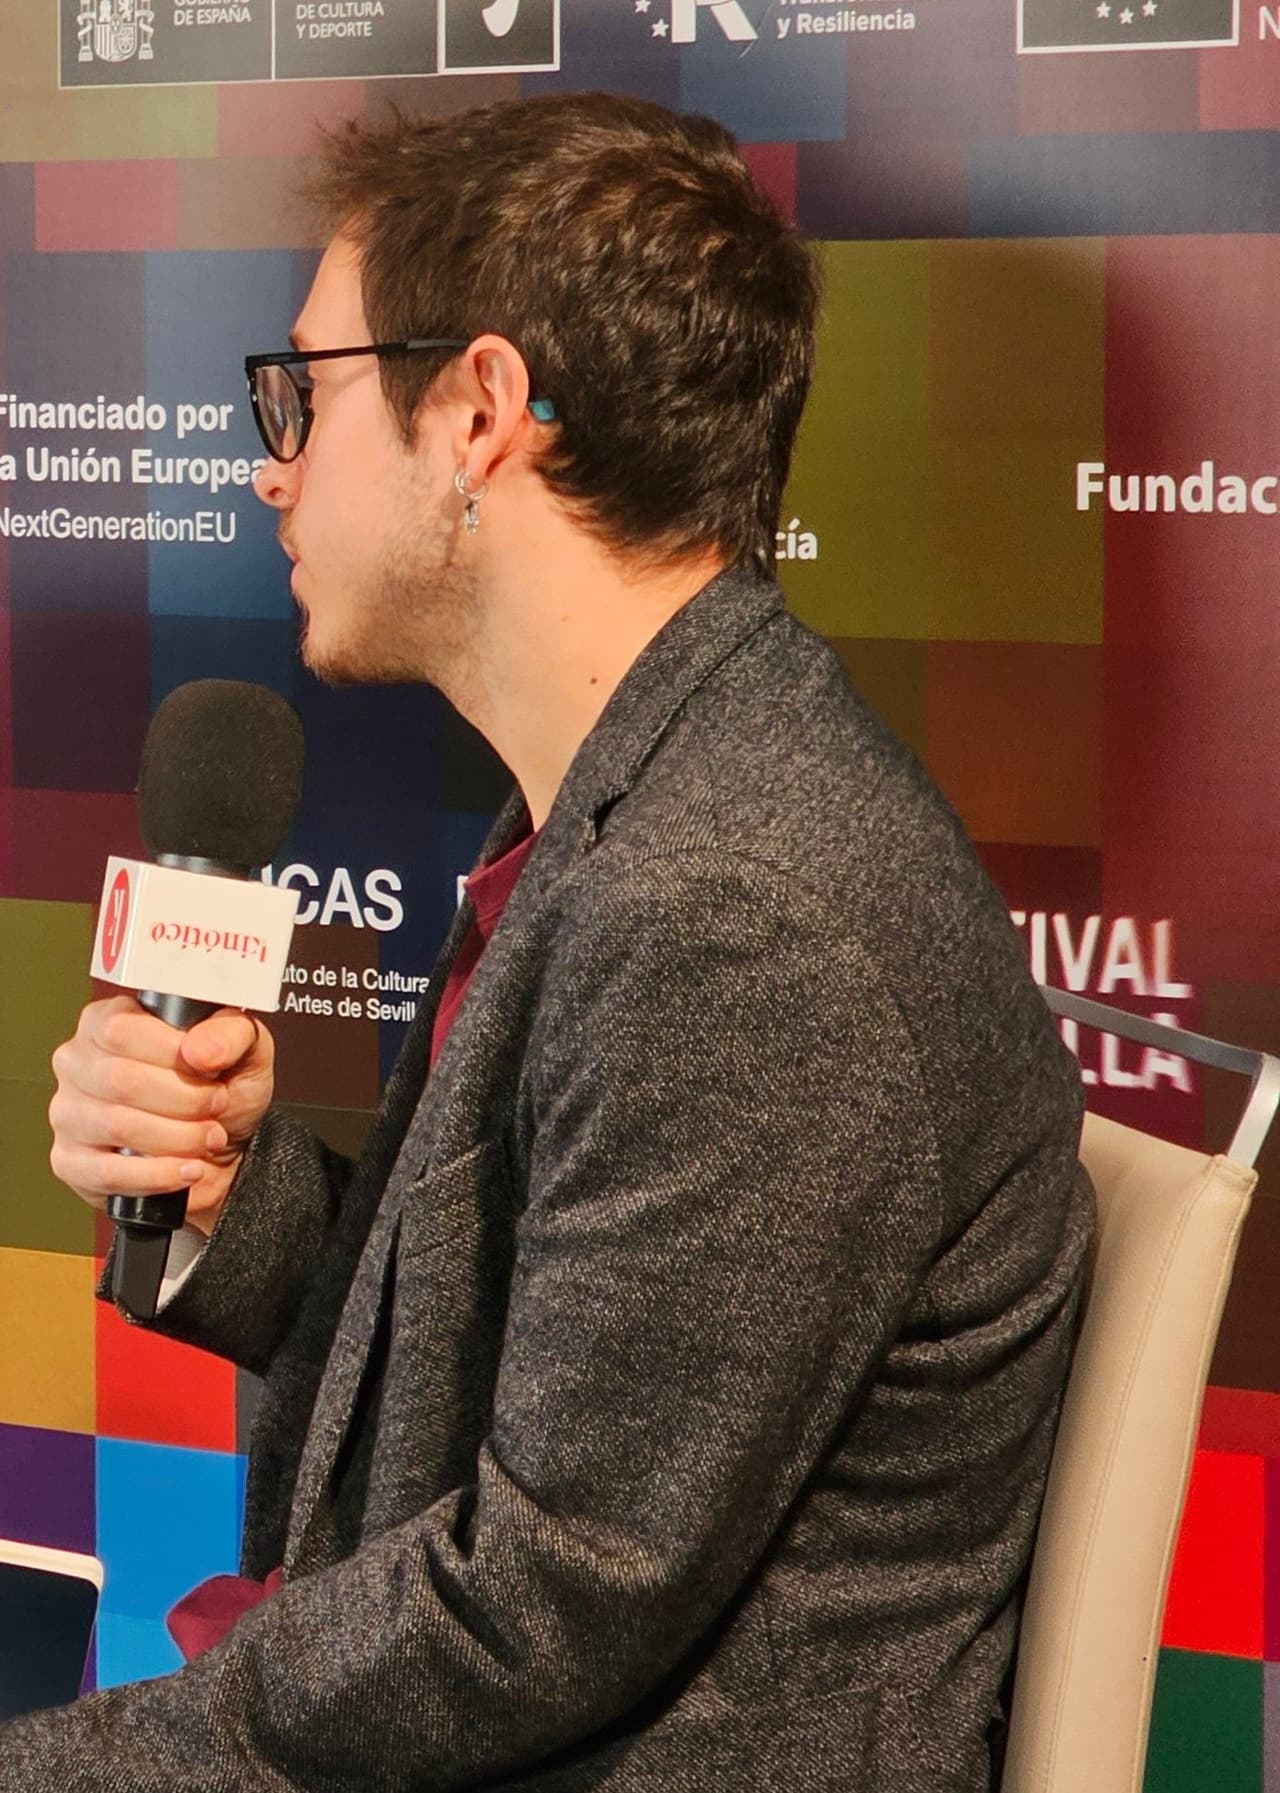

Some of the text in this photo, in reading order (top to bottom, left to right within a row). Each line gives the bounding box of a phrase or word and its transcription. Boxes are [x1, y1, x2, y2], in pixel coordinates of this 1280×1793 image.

[174, 5, 252, 26] DE ESPAÑA
[296, 1, 385, 20] DE CULTURA
[776, 17, 790, 39] y
[797, 9, 915, 34] Resiliencia
[296, 22, 373, 40] Y DEPORTE
[177, 402, 234, 439] por
[26, 447, 120, 483] Unión
[1076, 461, 1280, 514] Fundac
[1009, 911, 1193, 998] IVAL
[313, 965, 337, 987] de
[341, 967, 359, 989] la
[284, 992, 416, 1022] Artes de Sevill
